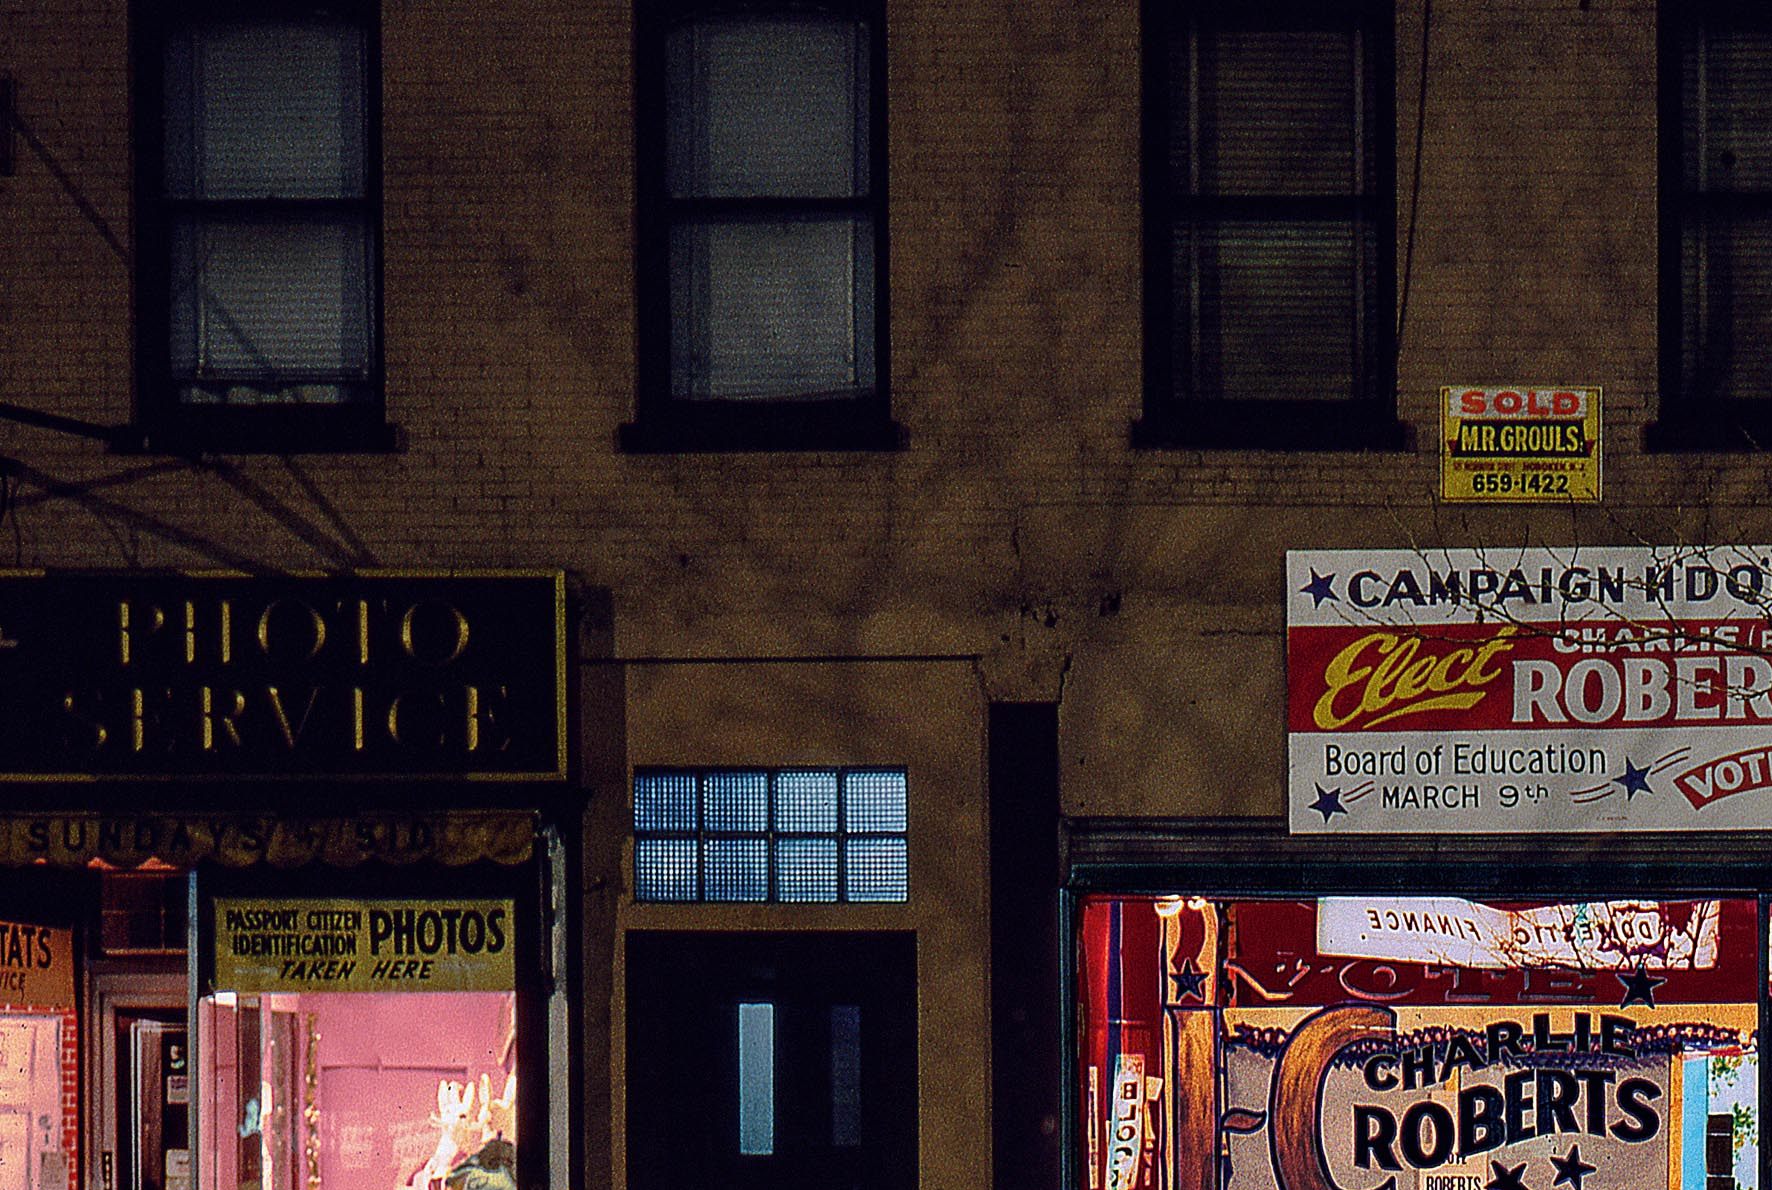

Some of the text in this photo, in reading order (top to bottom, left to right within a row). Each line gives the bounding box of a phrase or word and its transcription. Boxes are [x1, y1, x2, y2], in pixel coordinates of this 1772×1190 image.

[1460, 391, 1580, 416] SOLD
[1347, 566, 1625, 608] CAMPAIGN
[119, 600, 470, 664] PHOTO
[1312, 625, 1519, 730] Elect
[63, 685, 512, 751] SERVICE
[1325, 743, 1606, 776] Board of Education
[1382, 783, 1549, 809] MARCH 9th
[225, 909, 362, 932] PASSPORT CITIZEN
[369, 908, 506, 956] PHOTOS
[232, 934, 357, 956] IDENTIFICATION
[279, 960, 436, 980] TAKEN HERE
[1362, 1011, 1638, 1092] CHARLIE
[1352, 1068, 1664, 1171] ROBERTS
